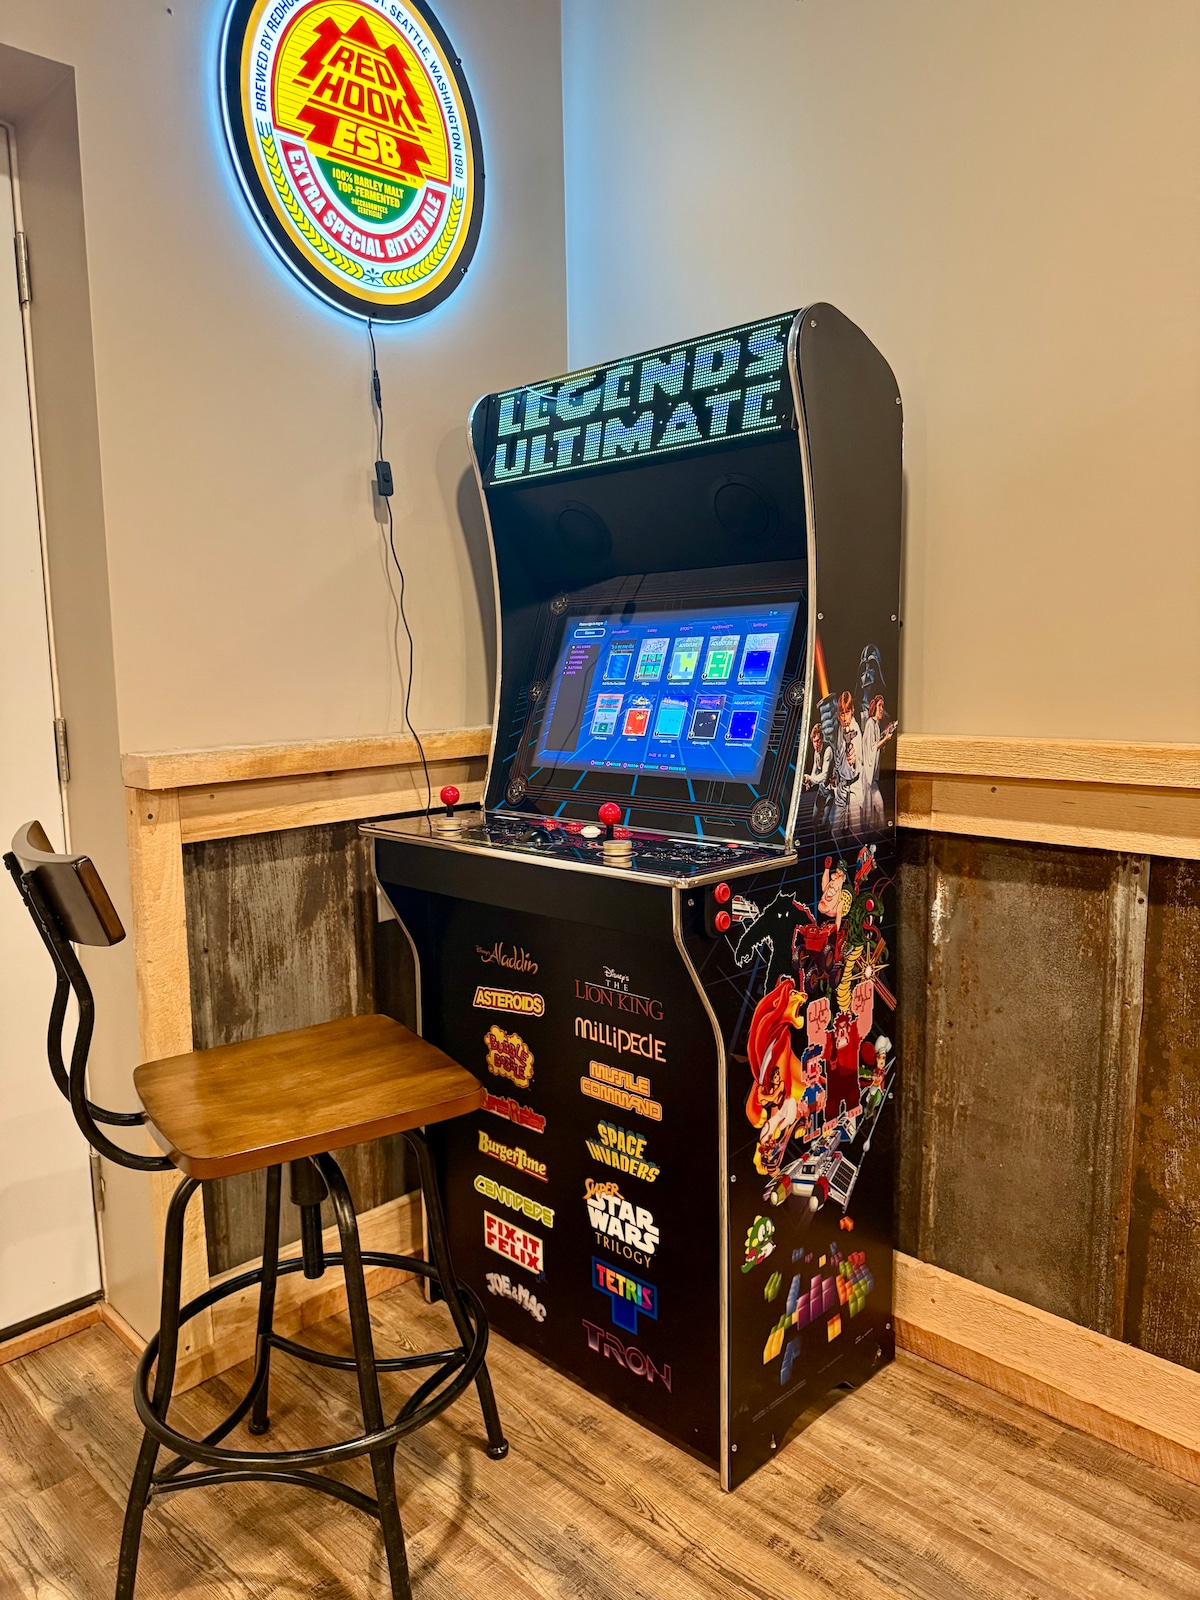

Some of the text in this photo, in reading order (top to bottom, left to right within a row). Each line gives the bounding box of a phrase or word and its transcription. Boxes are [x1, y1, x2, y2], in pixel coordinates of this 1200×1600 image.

[260, 29, 274, 51] BY
[255, 51, 269, 112] BREWED
[327, 45, 397, 91] RED
[312, 71, 415, 133] HOOK
[389, 5, 464, 179] SEATTLE, WASHINGTON 1981
[332, 118, 401, 169] ESB
[287, 150, 442, 259] EXTRA SPECIAL BITTER ALE
[332, 167, 404, 199] 100% BARLEY MALT
[337, 180, 400, 208] TOP-FERMENTED
[498, 324, 785, 437] LEGENDS
[494, 380, 782, 479] ULTIMATE
[480, 941, 539, 975] Aladdin
[475, 989, 543, 1014] ASTEROIDS
[575, 979, 665, 1021] LION KING
[605, 979, 629, 992] THE
[580, 1076, 663, 1122] COMMAND
[590, 1060, 651, 1098] MISSILE
[478, 1129, 547, 1176] BurgerTime
[585, 1140, 660, 1183] INVADERS
[597, 1120, 648, 1160] SPACE
[474, 1175, 555, 1229] CENTIPEDE
[586, 1191, 660, 1237] STAR
[486, 1215, 540, 1255] FIX-IT
[486, 1230, 541, 1272] FELIX
[586, 1204, 660, 1255] WARS
[595, 1231, 651, 1269] TRILOGY
[485, 1272, 512, 1298] JOE
[517, 1283, 547, 1323] MAC
[596, 1263, 653, 1311] TETRIS
[582, 1318, 672, 1394] TRON
